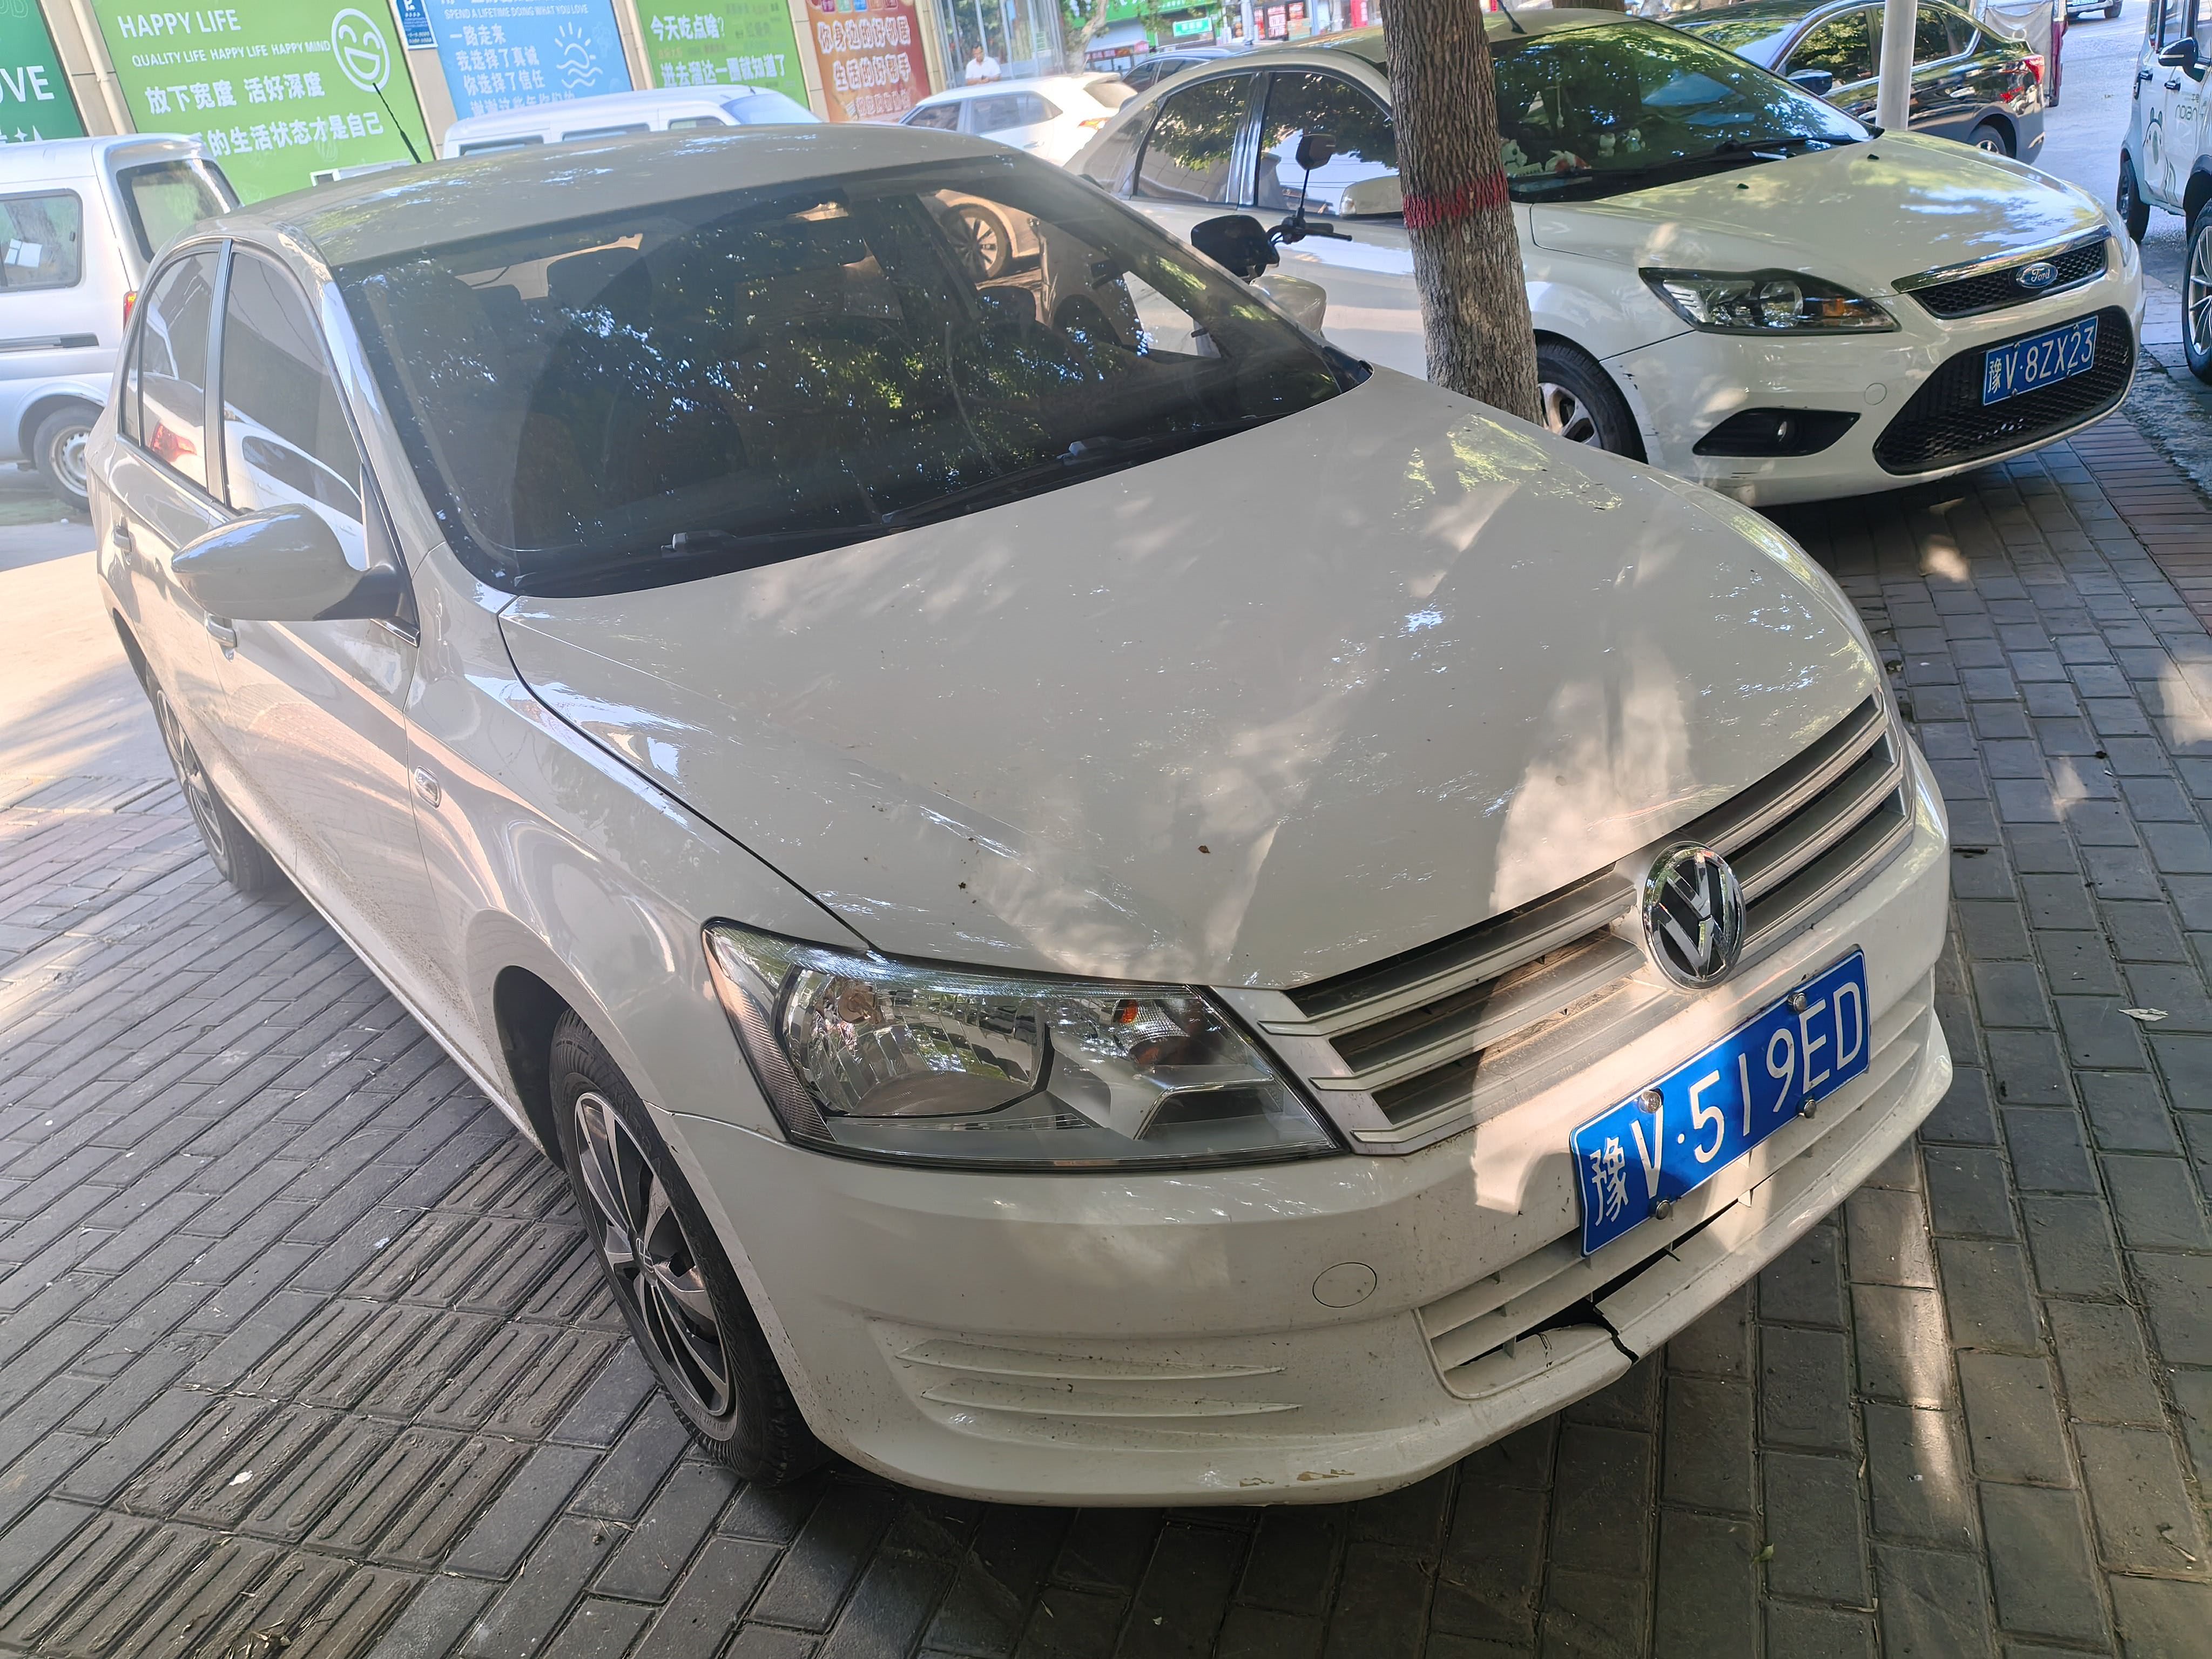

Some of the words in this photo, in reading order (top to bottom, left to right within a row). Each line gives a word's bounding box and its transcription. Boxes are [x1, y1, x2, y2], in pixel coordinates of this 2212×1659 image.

[117, 12, 191, 38] HAPPY
[195, 9, 241, 32] LIFE
[444, 9, 470, 19] SPEND
[472, 9, 478, 18] A
[478, 7, 510, 18] LIFETIME
[512, 6, 534, 17] DOING
[536, 5, 556, 15] WHAT
[556, 5, 571, 14] YOU
[571, 4, 589, 14] LOVE
[449, 23, 506, 46] 一路走来
[132, 51, 181, 67] QUALITY
[183, 49, 207, 63] LIFE
[210, 46, 245, 60] HAPPY
[246, 44, 268, 57] LIFE
[271, 42, 302, 55] HAPPY
[305, 40, 331, 52] MIND
[456, 45, 539, 72] 我选择了真诚
[0, 65, 55, 104] VE
[145, 79, 237, 114] 放下宽度
[243, 71, 325, 103] 活好深度
[463, 69, 545, 97] 你选择了信任
[190, 111, 384, 157] 的生活状态才是自己
[2031, 267, 2051, 282] Ford
